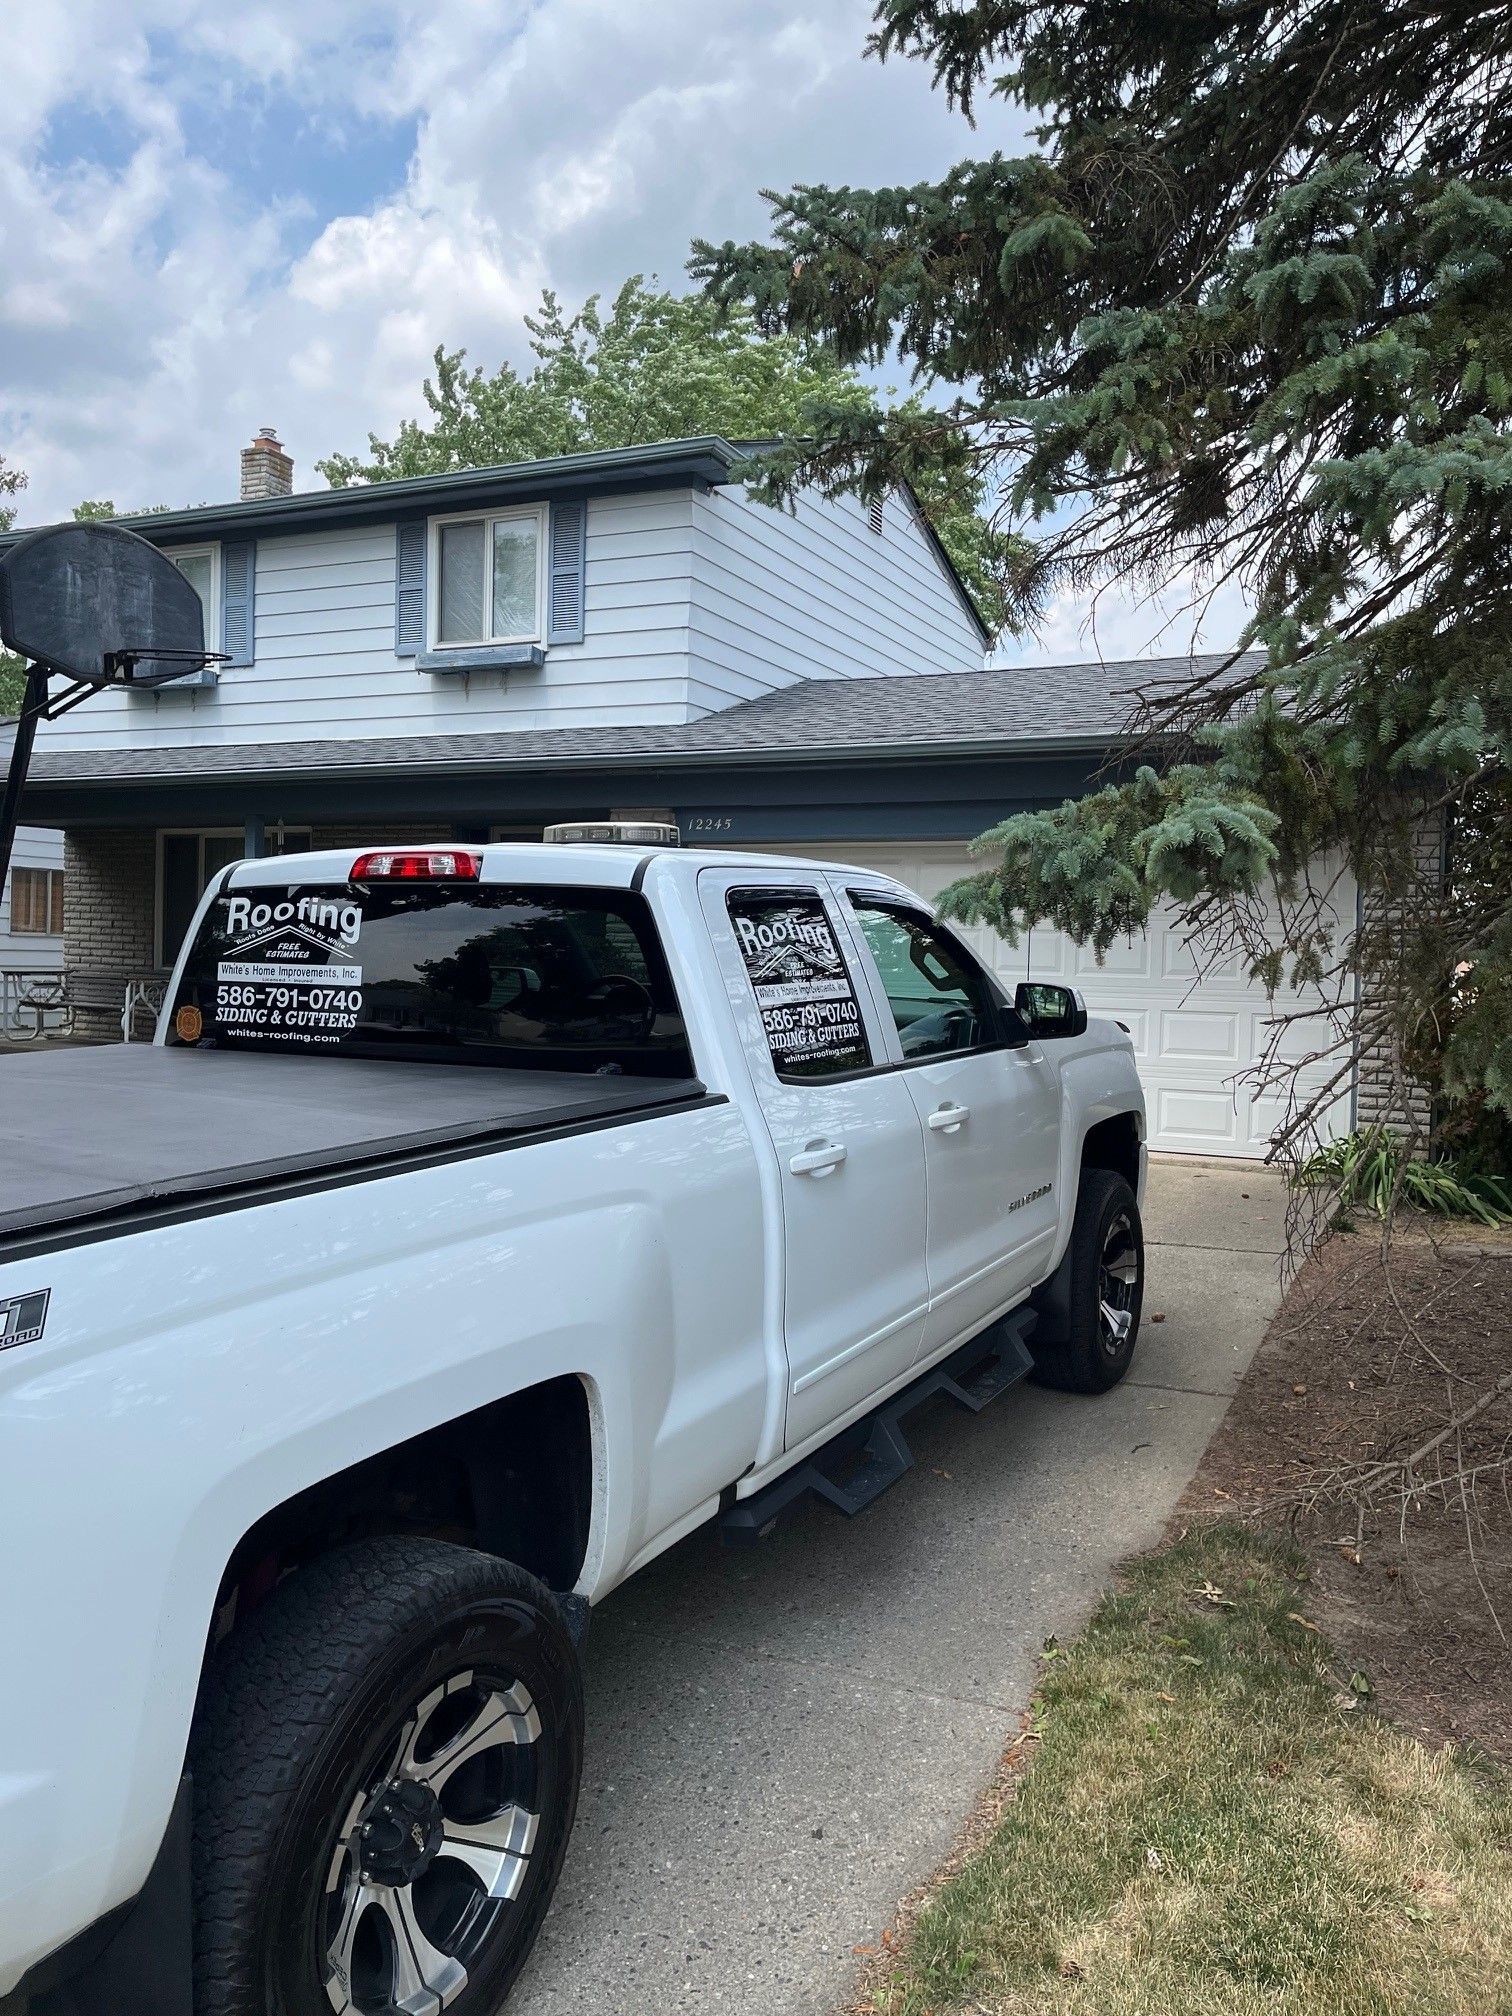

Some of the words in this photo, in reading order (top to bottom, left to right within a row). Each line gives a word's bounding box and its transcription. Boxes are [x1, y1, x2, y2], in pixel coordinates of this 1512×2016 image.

[689, 818, 732, 830] 12245
[227, 897, 362, 944] Roofing
[257, 925, 275, 935] Done
[299, 923, 317, 936] Right
[316, 931, 327, 941] by
[735, 917, 837, 960] Roofing
[265, 951, 310, 959] ESTIMATES
[277, 942, 301, 950] FREE
[221, 964, 250, 975] White's
[252, 966, 276, 976] Home
[278, 967, 339, 979] Improvements,
[342, 970, 357, 979] Inc.
[216, 986, 363, 1011] 586-791-0740
[215, 1007, 268, 1024] SIDING
[270, 1010, 282, 1025] &
[285, 1010, 358, 1028] GUTTERS
[763, 1001, 858, 1031] 586-791-0740
[227, 1029, 340, 1043] whites-roofing.com
[769, 1031, 806, 1050] SIDING
[808, 1028, 818, 1043] &
[817, 1022, 860, 1042] GUTTERS
[784, 1045, 856, 1063] whites-roofing.com
